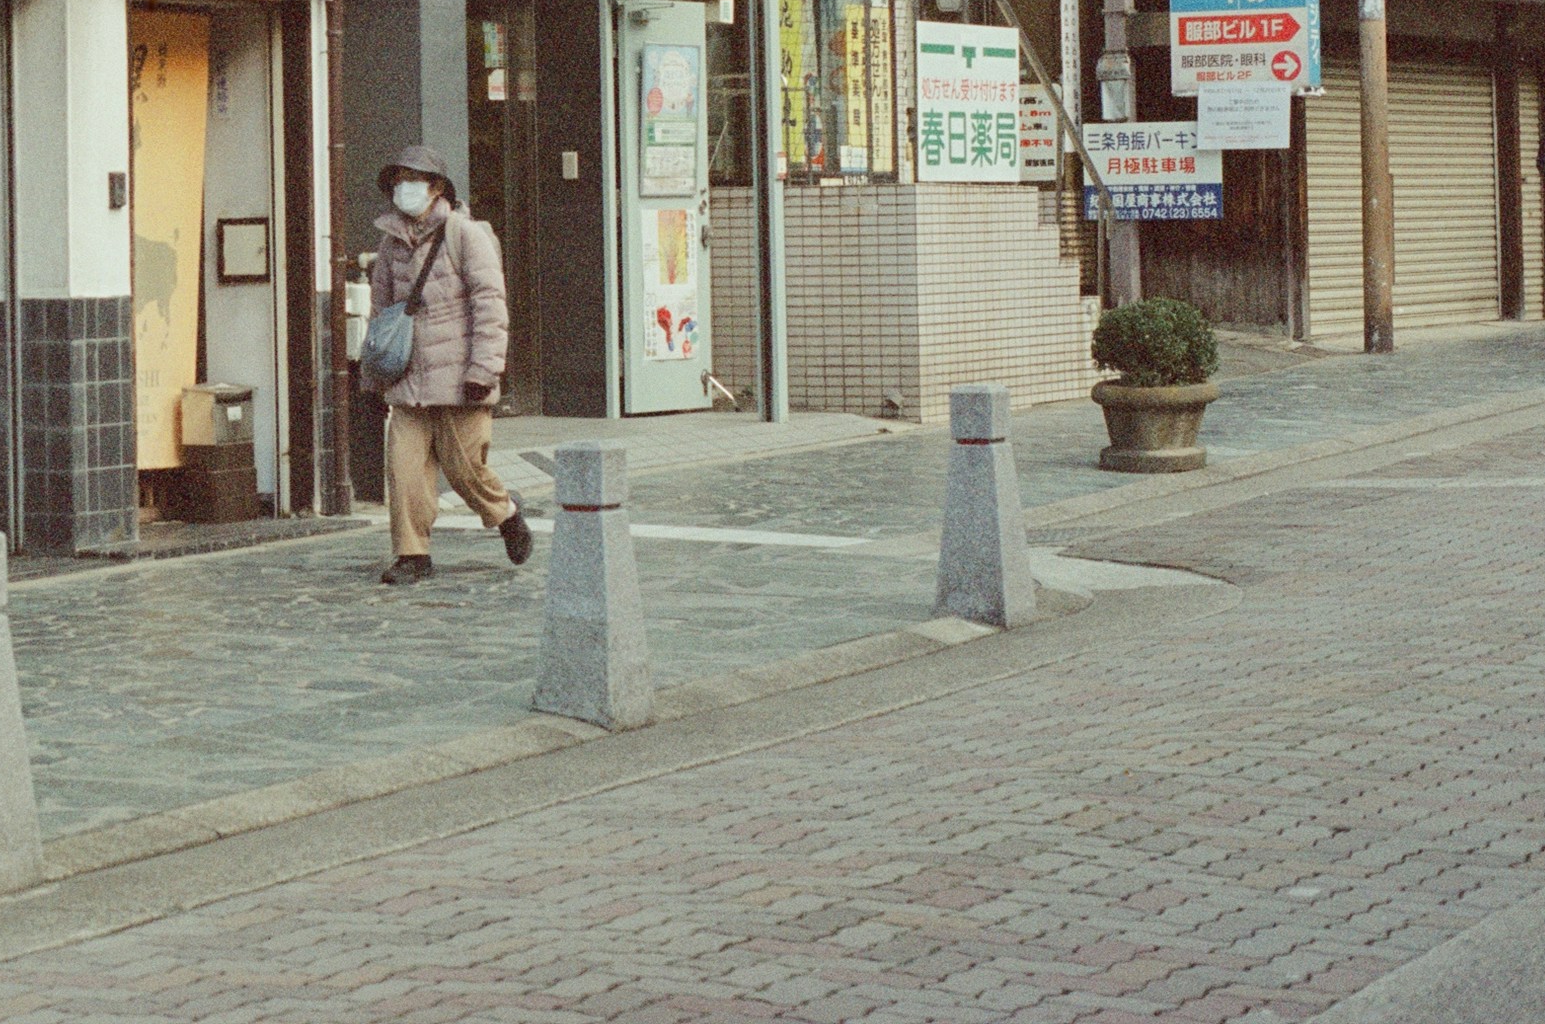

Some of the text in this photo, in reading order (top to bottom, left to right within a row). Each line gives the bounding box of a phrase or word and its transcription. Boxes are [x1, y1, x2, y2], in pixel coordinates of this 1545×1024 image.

[1185, 19, 1284, 42] 服部ビル 1F
[921, 77, 1017, 103] 処方せん受け付けます
[921, 107, 1017, 168] 春日薬局
[1107, 156, 1195, 175] 月極駐車場
[1142, 207, 1218, 220] 0742(23)6554
